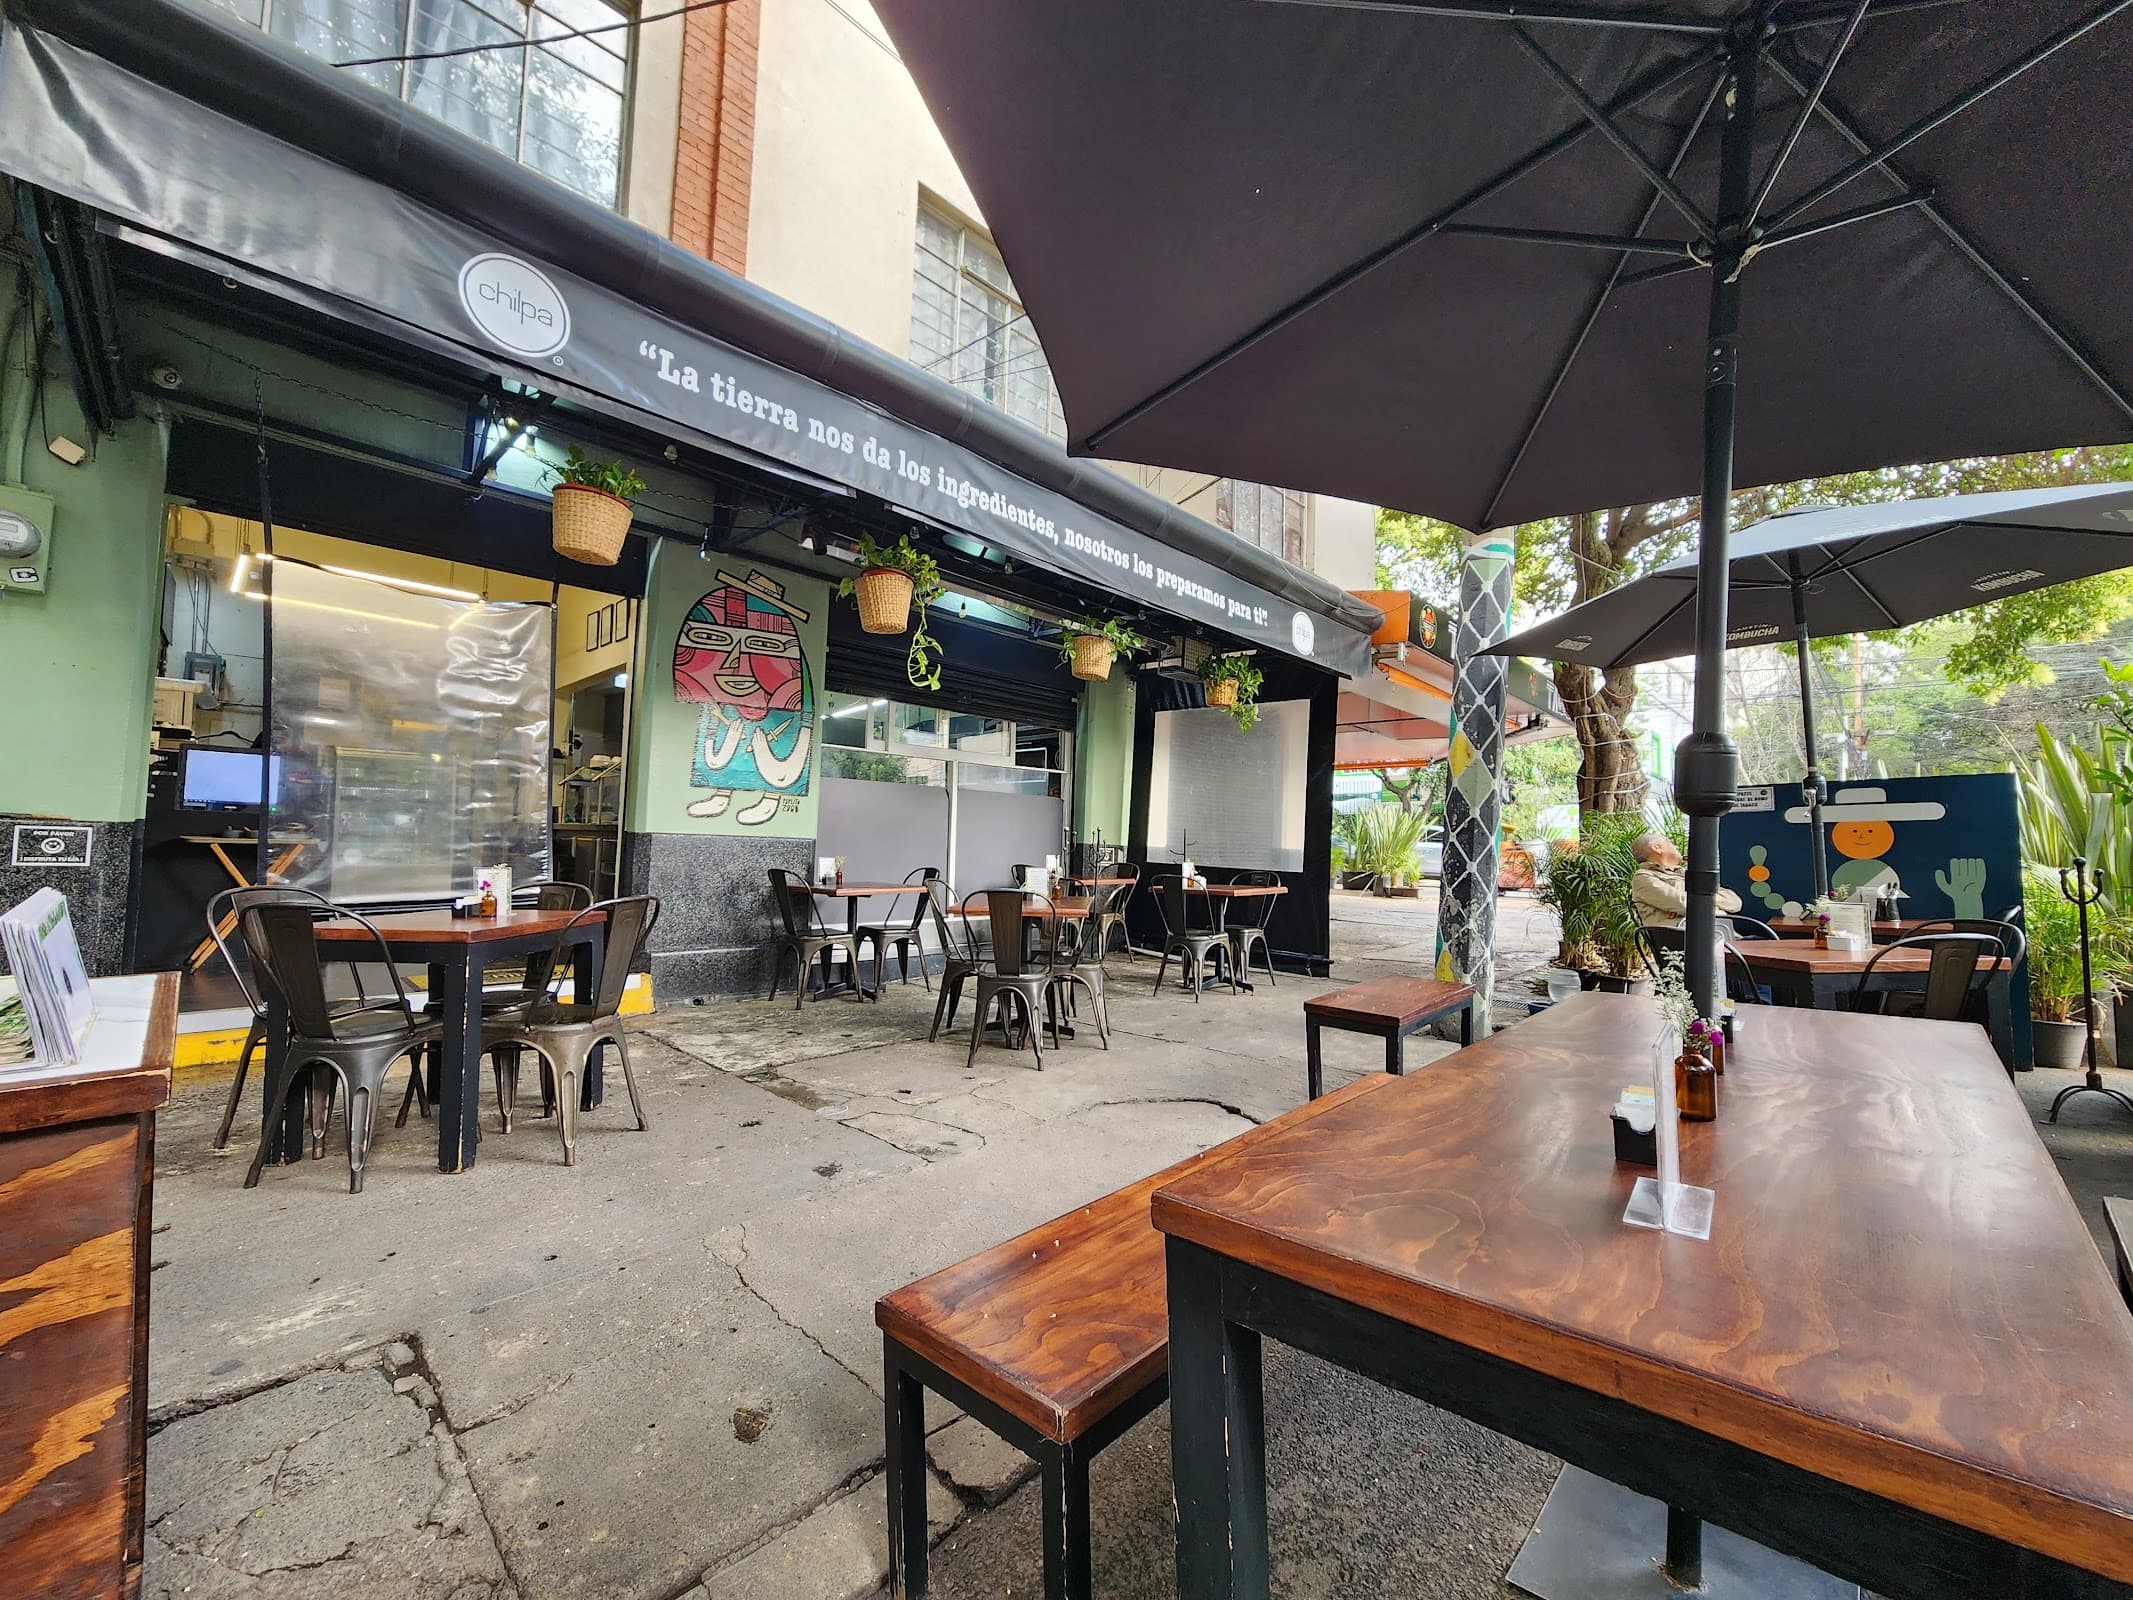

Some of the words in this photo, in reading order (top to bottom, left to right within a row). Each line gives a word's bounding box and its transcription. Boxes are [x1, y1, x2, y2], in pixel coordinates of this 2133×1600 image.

[479, 281, 553, 328] chilpa
[639, 340, 700, 393] “La
[710, 372, 799, 433] tierra
[808, 417, 855, 455] nos
[862, 436, 891, 471] da
[897, 449, 931, 486] los
[937, 466, 1059, 546] ingredientes,
[1064, 527, 1130, 570] nosotros
[1132, 552, 1154, 579] los
[1156, 567, 1226, 609] preparamos
[1227, 598, 1252, 621] para
[1726, 625, 1780, 641] OMBUCHA
